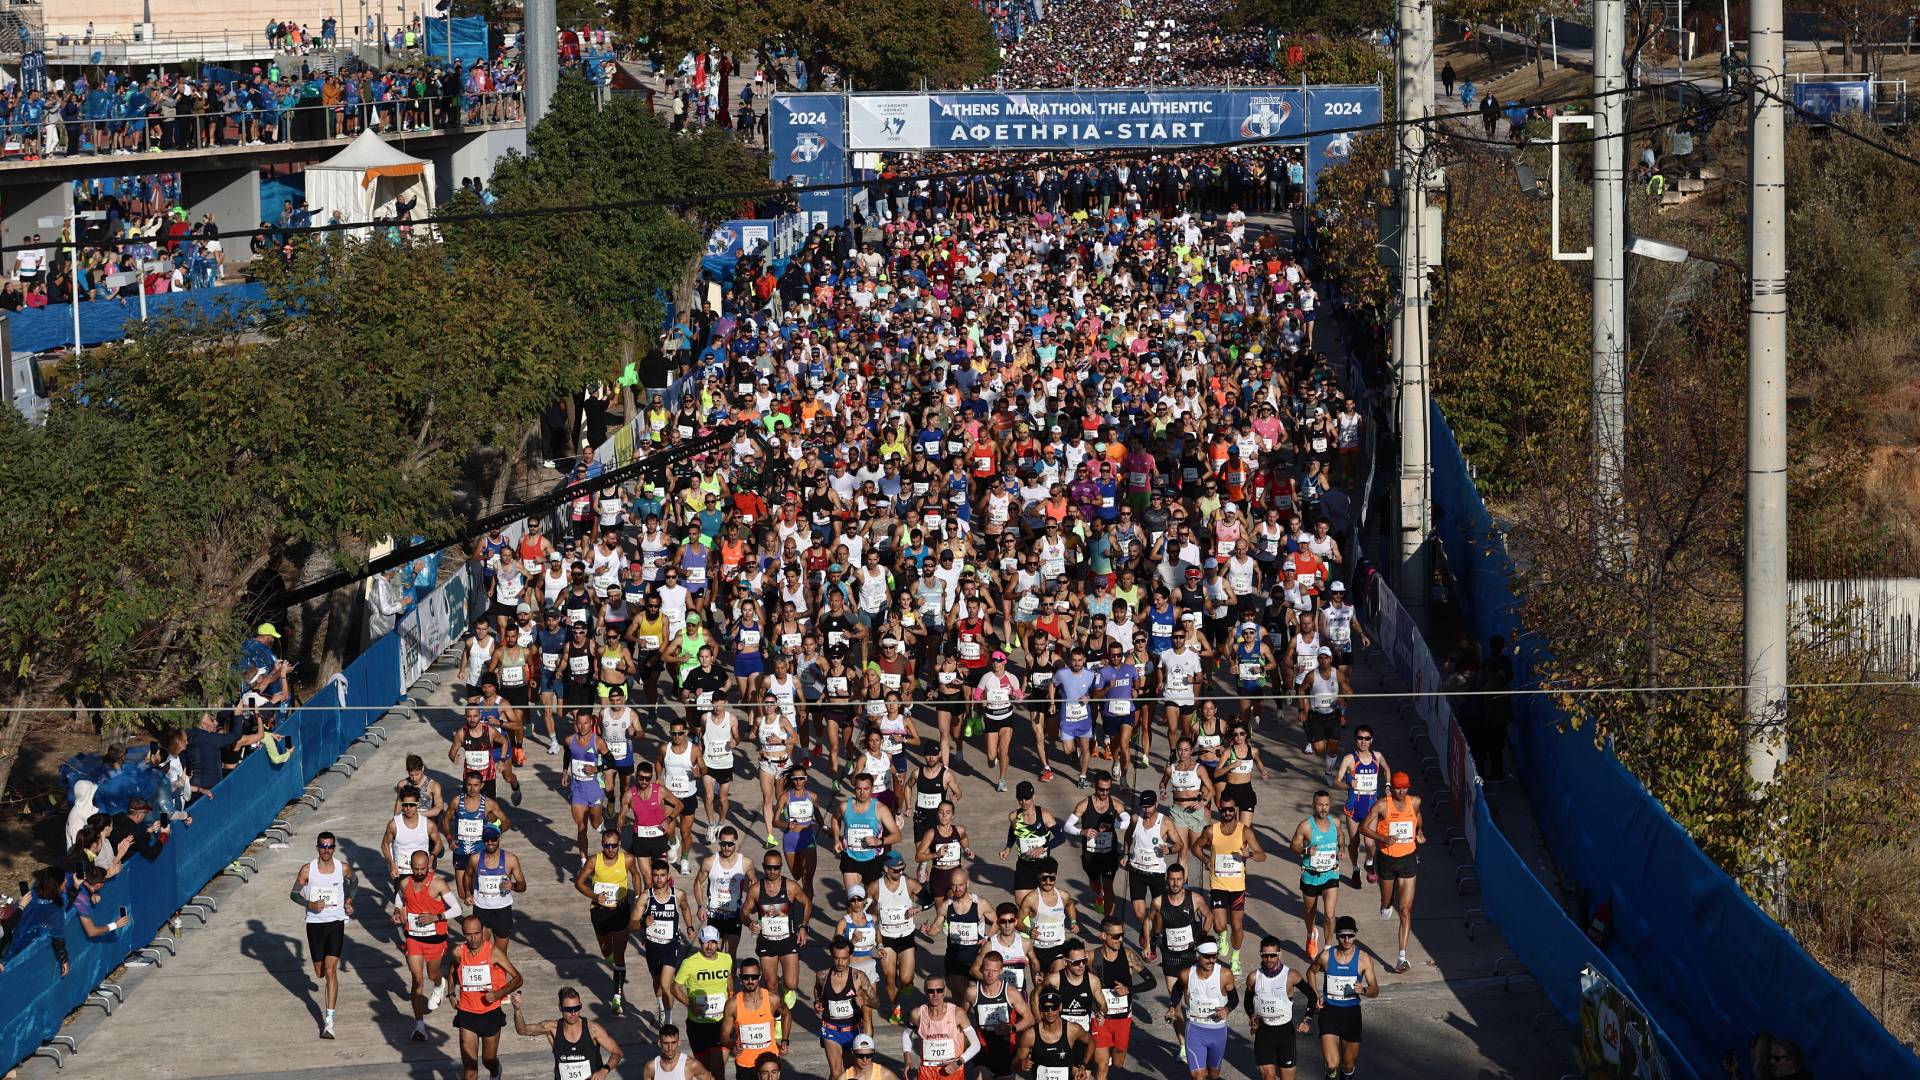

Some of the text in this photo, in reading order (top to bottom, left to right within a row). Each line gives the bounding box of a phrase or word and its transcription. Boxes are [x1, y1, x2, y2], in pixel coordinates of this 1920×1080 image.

[941, 101, 1213, 116] ATHENS MARATHON. THE AUTHENTIC
[1324, 102, 1362, 115] 2024
[789, 112, 827, 125] 2024
